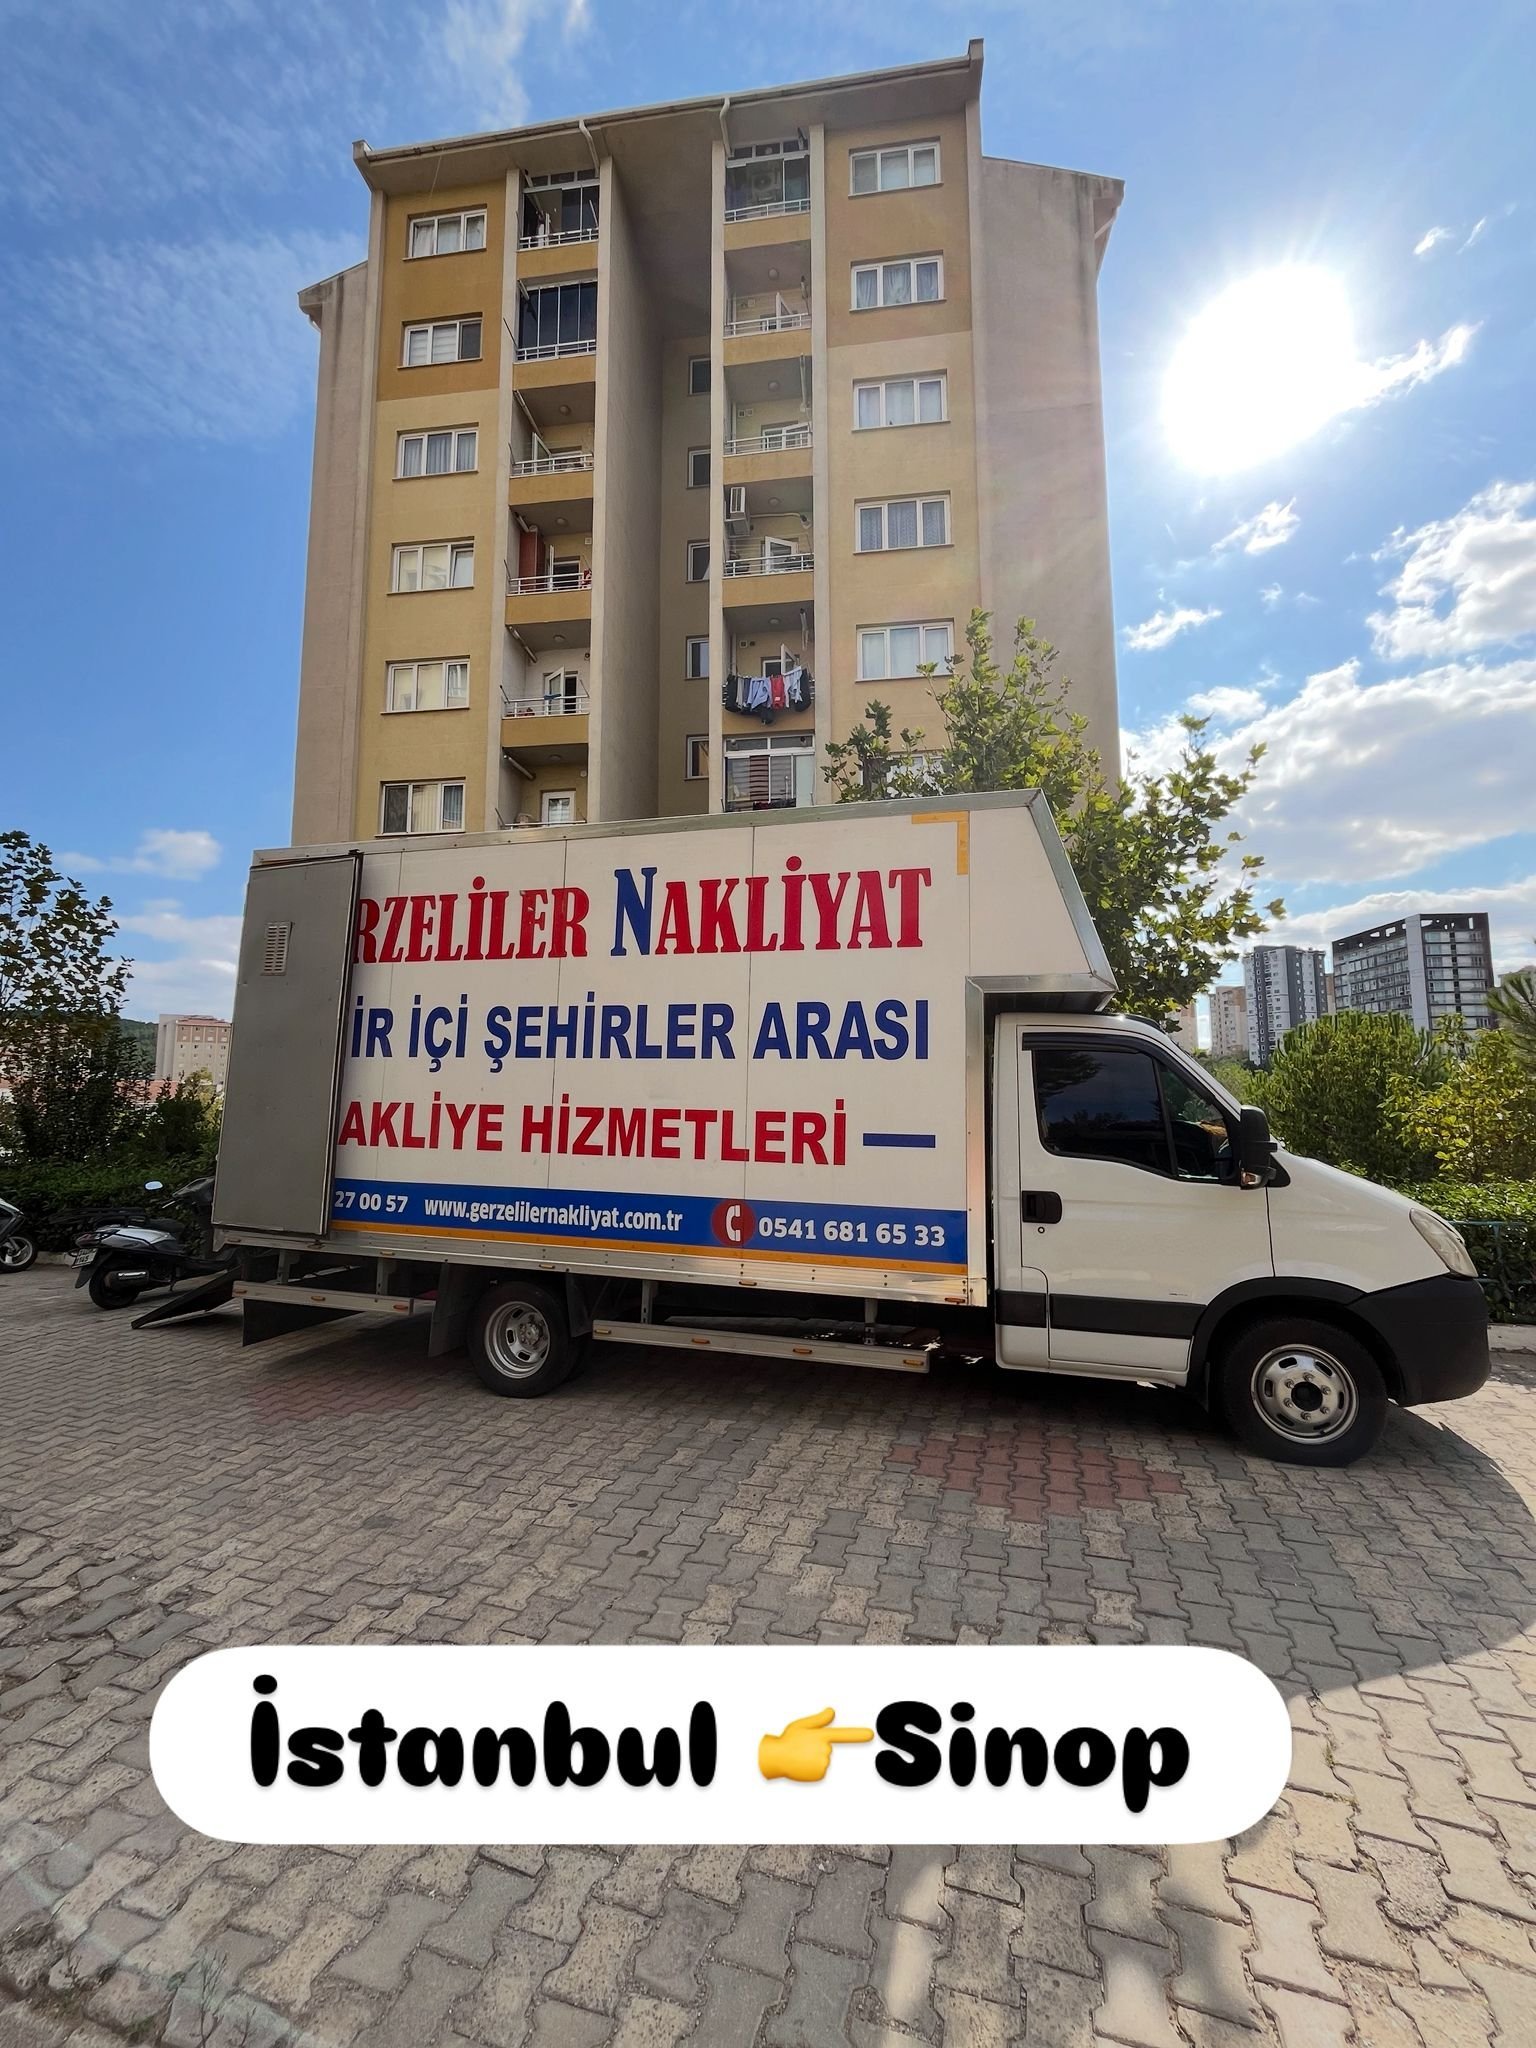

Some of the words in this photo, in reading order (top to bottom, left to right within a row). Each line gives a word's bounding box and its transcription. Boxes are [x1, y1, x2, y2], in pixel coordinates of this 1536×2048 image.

[352, 875, 591, 964] RZELİLER
[610, 855, 932, 957] NAKLİYAT
[350, 995, 395, 1059] İR
[408, 994, 470, 1073] İÇİ
[483, 991, 736, 1073] ŞEHİRLER
[752, 999, 929, 1061] ARASI
[337, 1091, 505, 1152] AKLİYE
[520, 1092, 847, 1167] HİZMETLERİ
[334, 1190, 356, 1209] 27
[359, 1192, 382, 1211] 00
[385, 1194, 409, 1214] 57
[424, 1198, 684, 1231] www.gerzelilernakliyat.com.tr
[758, 1216, 817, 1240] 0541
[823, 1220, 869, 1243] 681
[875, 1223, 907, 1245] 65
[914, 1225, 946, 1247] 33
